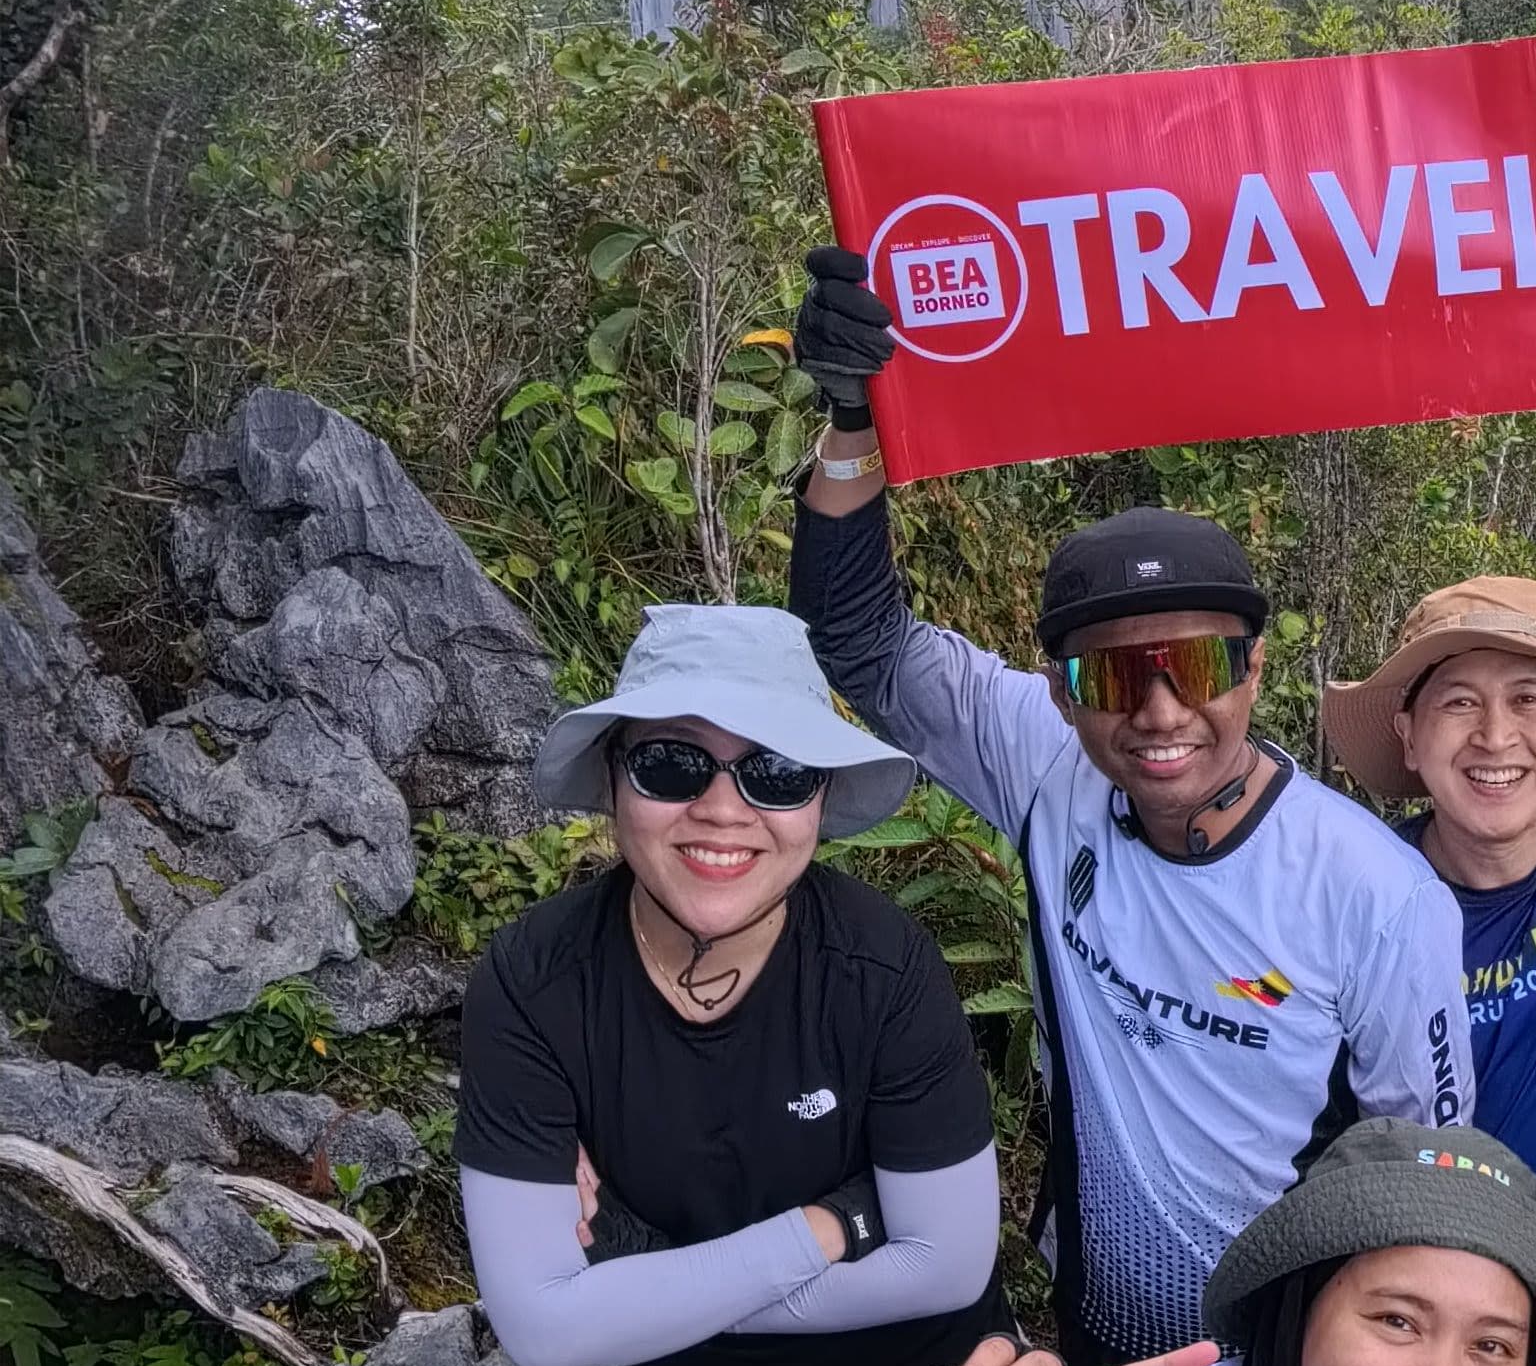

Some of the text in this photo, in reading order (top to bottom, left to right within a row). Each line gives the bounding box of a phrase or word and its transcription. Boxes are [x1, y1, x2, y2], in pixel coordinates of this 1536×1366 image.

[908, 257, 988, 296] BEA
[912, 292, 989, 314] BORNEO
[1428, 1007, 1462, 1128] DING
